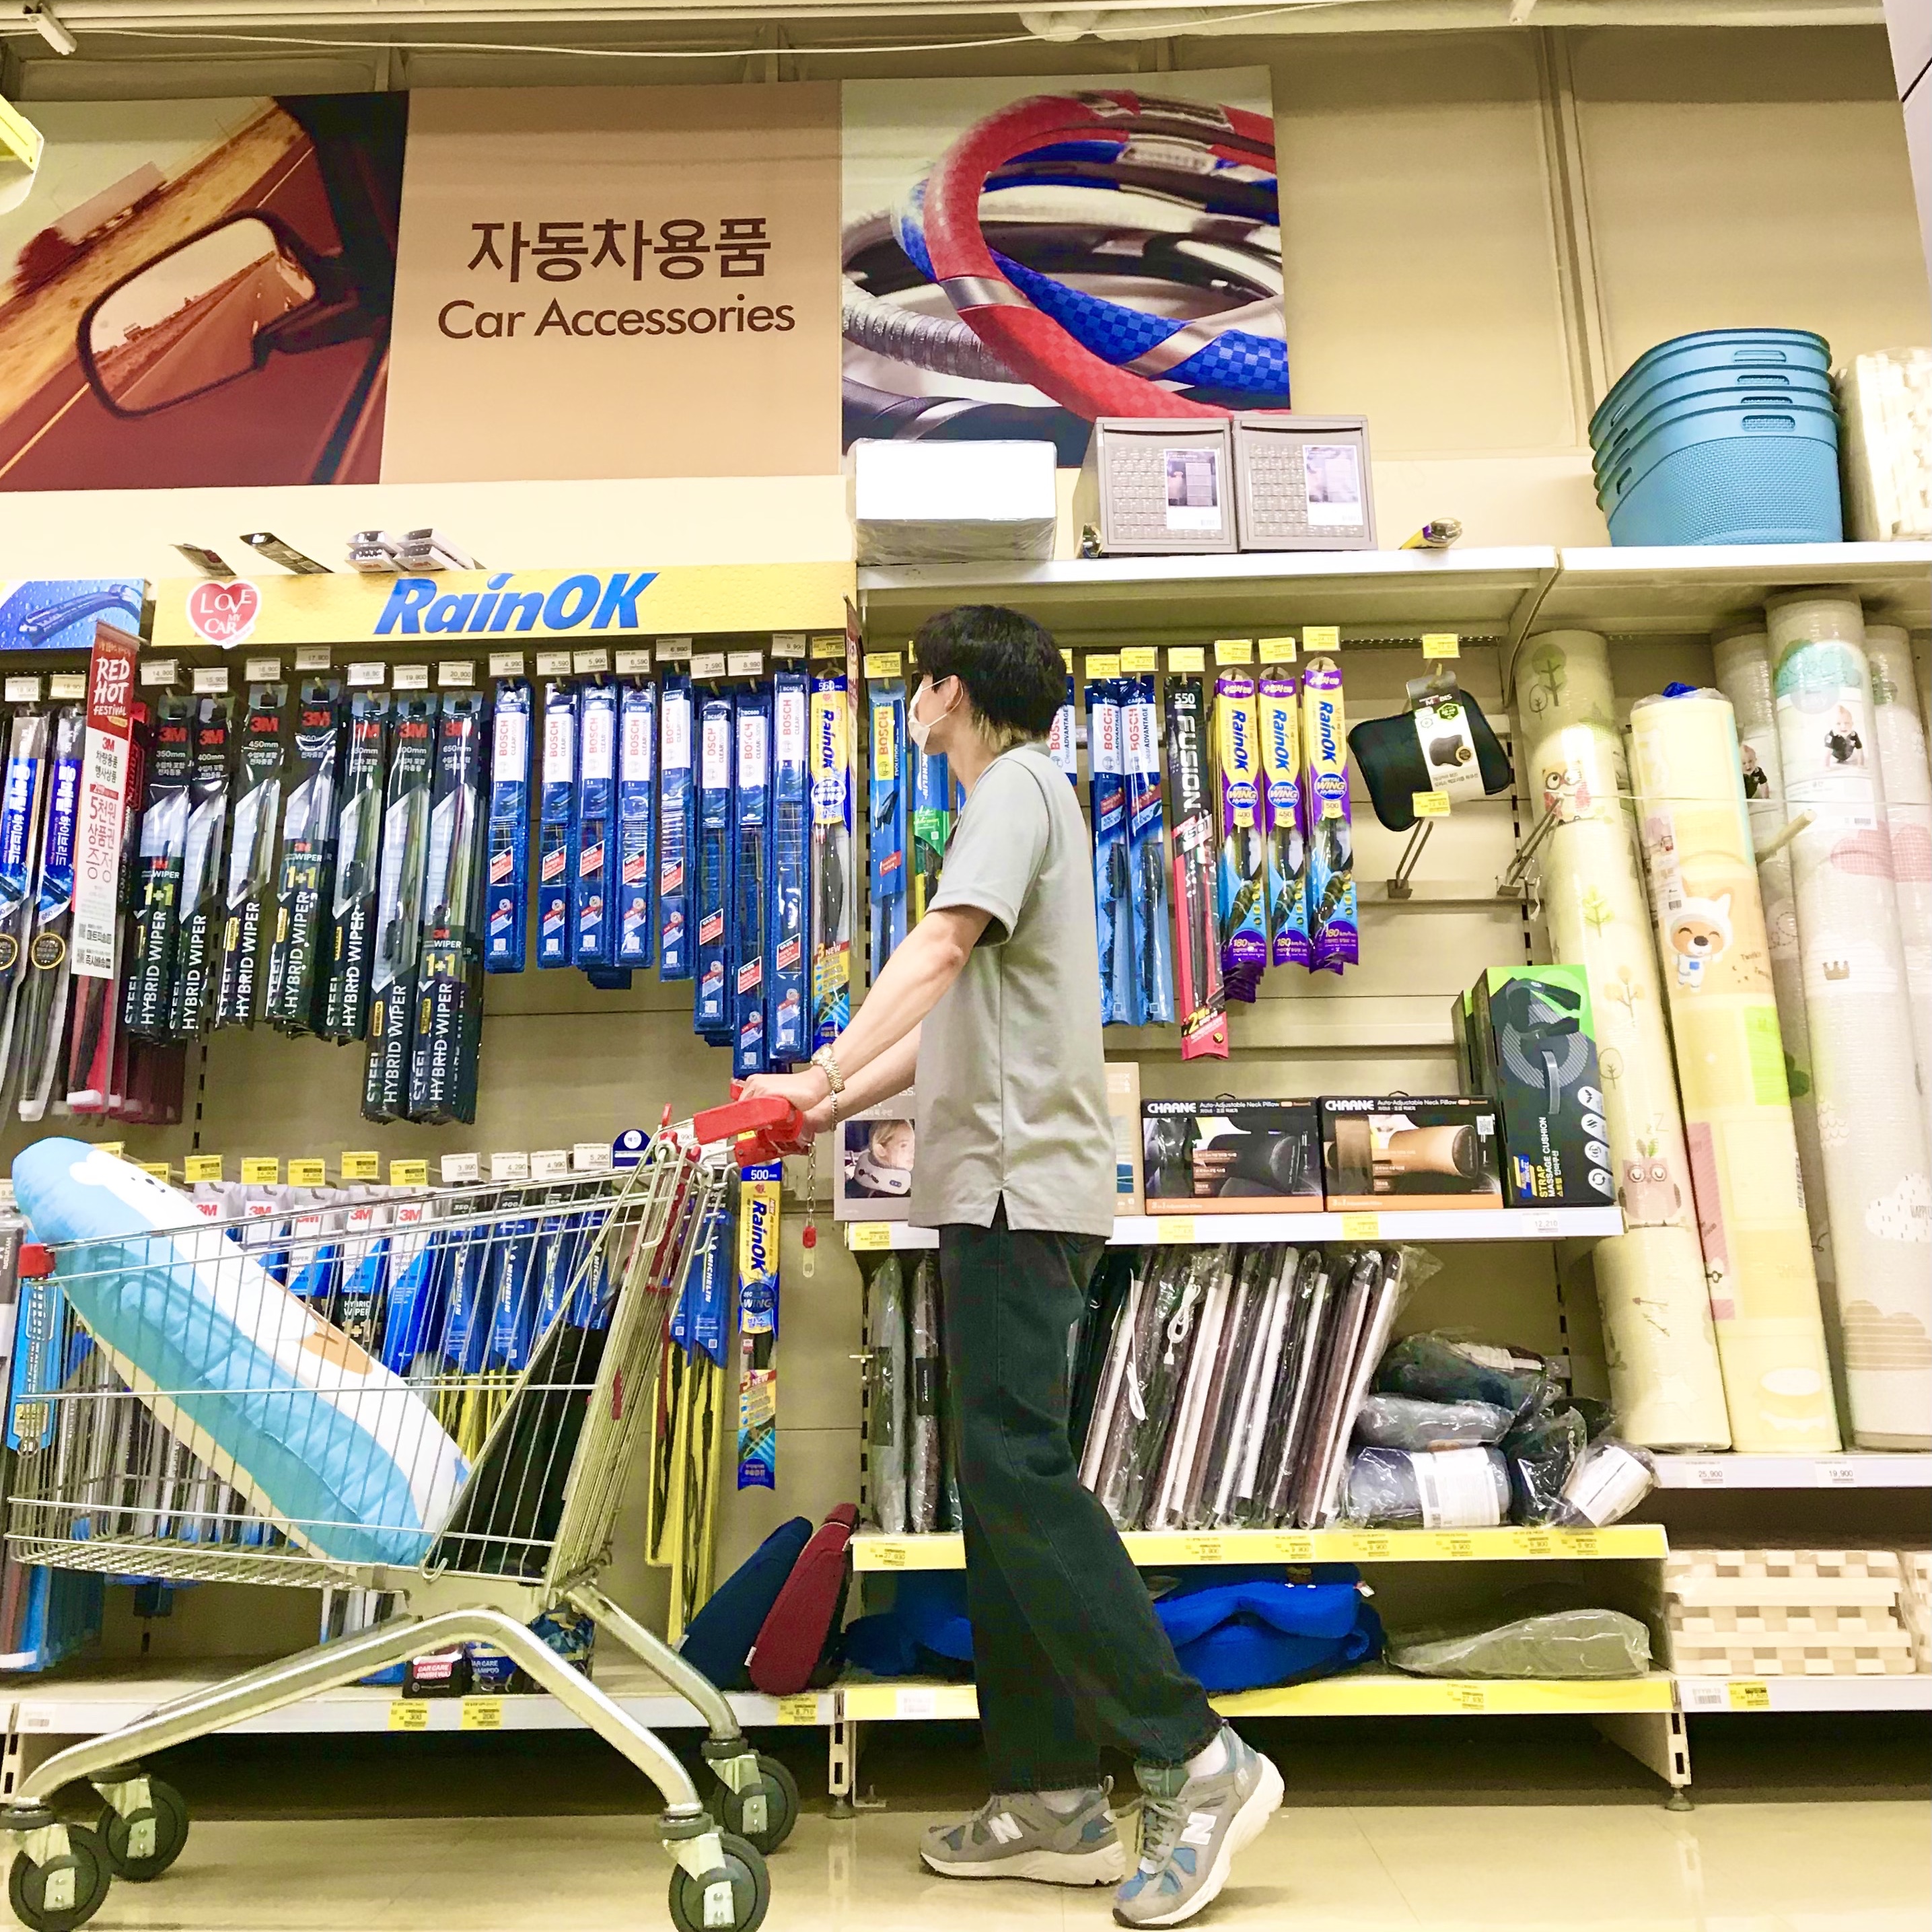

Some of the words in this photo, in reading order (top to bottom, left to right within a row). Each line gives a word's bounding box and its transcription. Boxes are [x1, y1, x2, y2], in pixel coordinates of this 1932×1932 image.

[468, 218, 771, 283] 자동차용품
[438, 299, 526, 339] Car
[534, 293, 795, 336] Accessories
[200, 588, 253, 614] LOVE
[373, 572, 660, 635] RainOK
[204, 618, 238, 635] CAR
[227, 614, 242, 622] MY
[96, 655, 131, 682] RED
[94, 680, 129, 705] HOT
[1174, 692, 1196, 704] 550
[250, 716, 279, 733] 3M
[301, 711, 331, 727] 3M
[399, 722, 428, 739] 3M
[782, 699, 792, 736] BOSCH
[1104, 707, 1113, 751] BOSCH
[102, 737, 115, 752] 3M
[159, 726, 188, 742] 3M
[199, 729, 224, 745] 3M
[248, 740, 279, 748] 450mm
[499, 719, 509, 756] BOSCH
[549, 721, 559, 758] BOSCH
[589, 717, 599, 754] BOSCH
[630, 719, 640, 756] BOSCH
[821, 709, 836, 769] RainOK
[878, 710, 889, 756] BOSCH
[1232, 709, 1249, 773] RainOK
[1273, 709, 1291, 773] RainOK
[1319, 701, 1337, 765] RainOK
[155, 750, 186, 758] 350mm
[198, 753, 225, 761] 400mm
[1177, 715, 1201, 813] FUSION
[1229, 790, 1256, 799] WING
[1270, 789, 1297, 799] WING
[1316, 781, 1345, 790] WING
[90, 796, 117, 826] 5천원
[87, 824, 115, 849] 상품권
[85, 847, 114, 884] 증정
[295, 853, 323, 862] WIPER
[153, 870, 180, 880] WIPER
[287, 865, 317, 888] 1+1
[144, 883, 174, 906] 1+1
[242, 901, 260, 954] WIPER
[292, 891, 311, 946] WIPER
[148, 910, 167, 963] WIPER
[188, 914, 207, 970] WIPER
[349, 910, 365, 964] WIPER
[434, 939, 462, 948] WIPER
[1233, 939, 1248, 947] 180
[1277, 937, 1291, 947] 180
[1325, 928, 1339, 937] 180
[825, 944, 842, 956] NEW
[426, 953, 456, 976] 1+1
[236, 956, 254, 1017] HYBRID
[285, 947, 303, 1009] HYBRID
[141, 962, 160, 1026] HYBRID
[182, 970, 200, 1030] HYBRID
[342, 963, 359, 1027] HYBRID
[388, 985, 406, 1040] WIPER
[435, 982, 452, 1035] WIPER
[383, 1041, 402, 1103] HYBRID
[429, 1035, 447, 1102] HYBRID
[1147, 1102, 1197, 1114] CHAANE
[1262, 1100, 1280, 1108] Pillow
[1325, 1100, 1375, 1111] CHAANE
[1542, 1116, 1550, 1154] CUSHION
[1539, 1165, 1548, 1198] STRAP
[1546, 1154, 1556, 1197] MASSAGE
[350, 1209, 371, 1221] 3M
[398, 1209, 422, 1221] 3M
[1534, 1219, 1559, 1229] 12,210
[750, 1200, 770, 1272] RainOK
[504, 1263, 513, 1314] MICHELIN
[705, 1252, 714, 1303] MICHELIN
[343, 1308, 370, 1317] WPER
[344, 1299, 370, 1308] HYRID
[742, 1298, 772, 1308] WING
[752, 1374, 770, 1387] NEW
[1698, 1470, 1723, 1479] 25,900
[1828, 1469, 1853, 1478] 19,900
